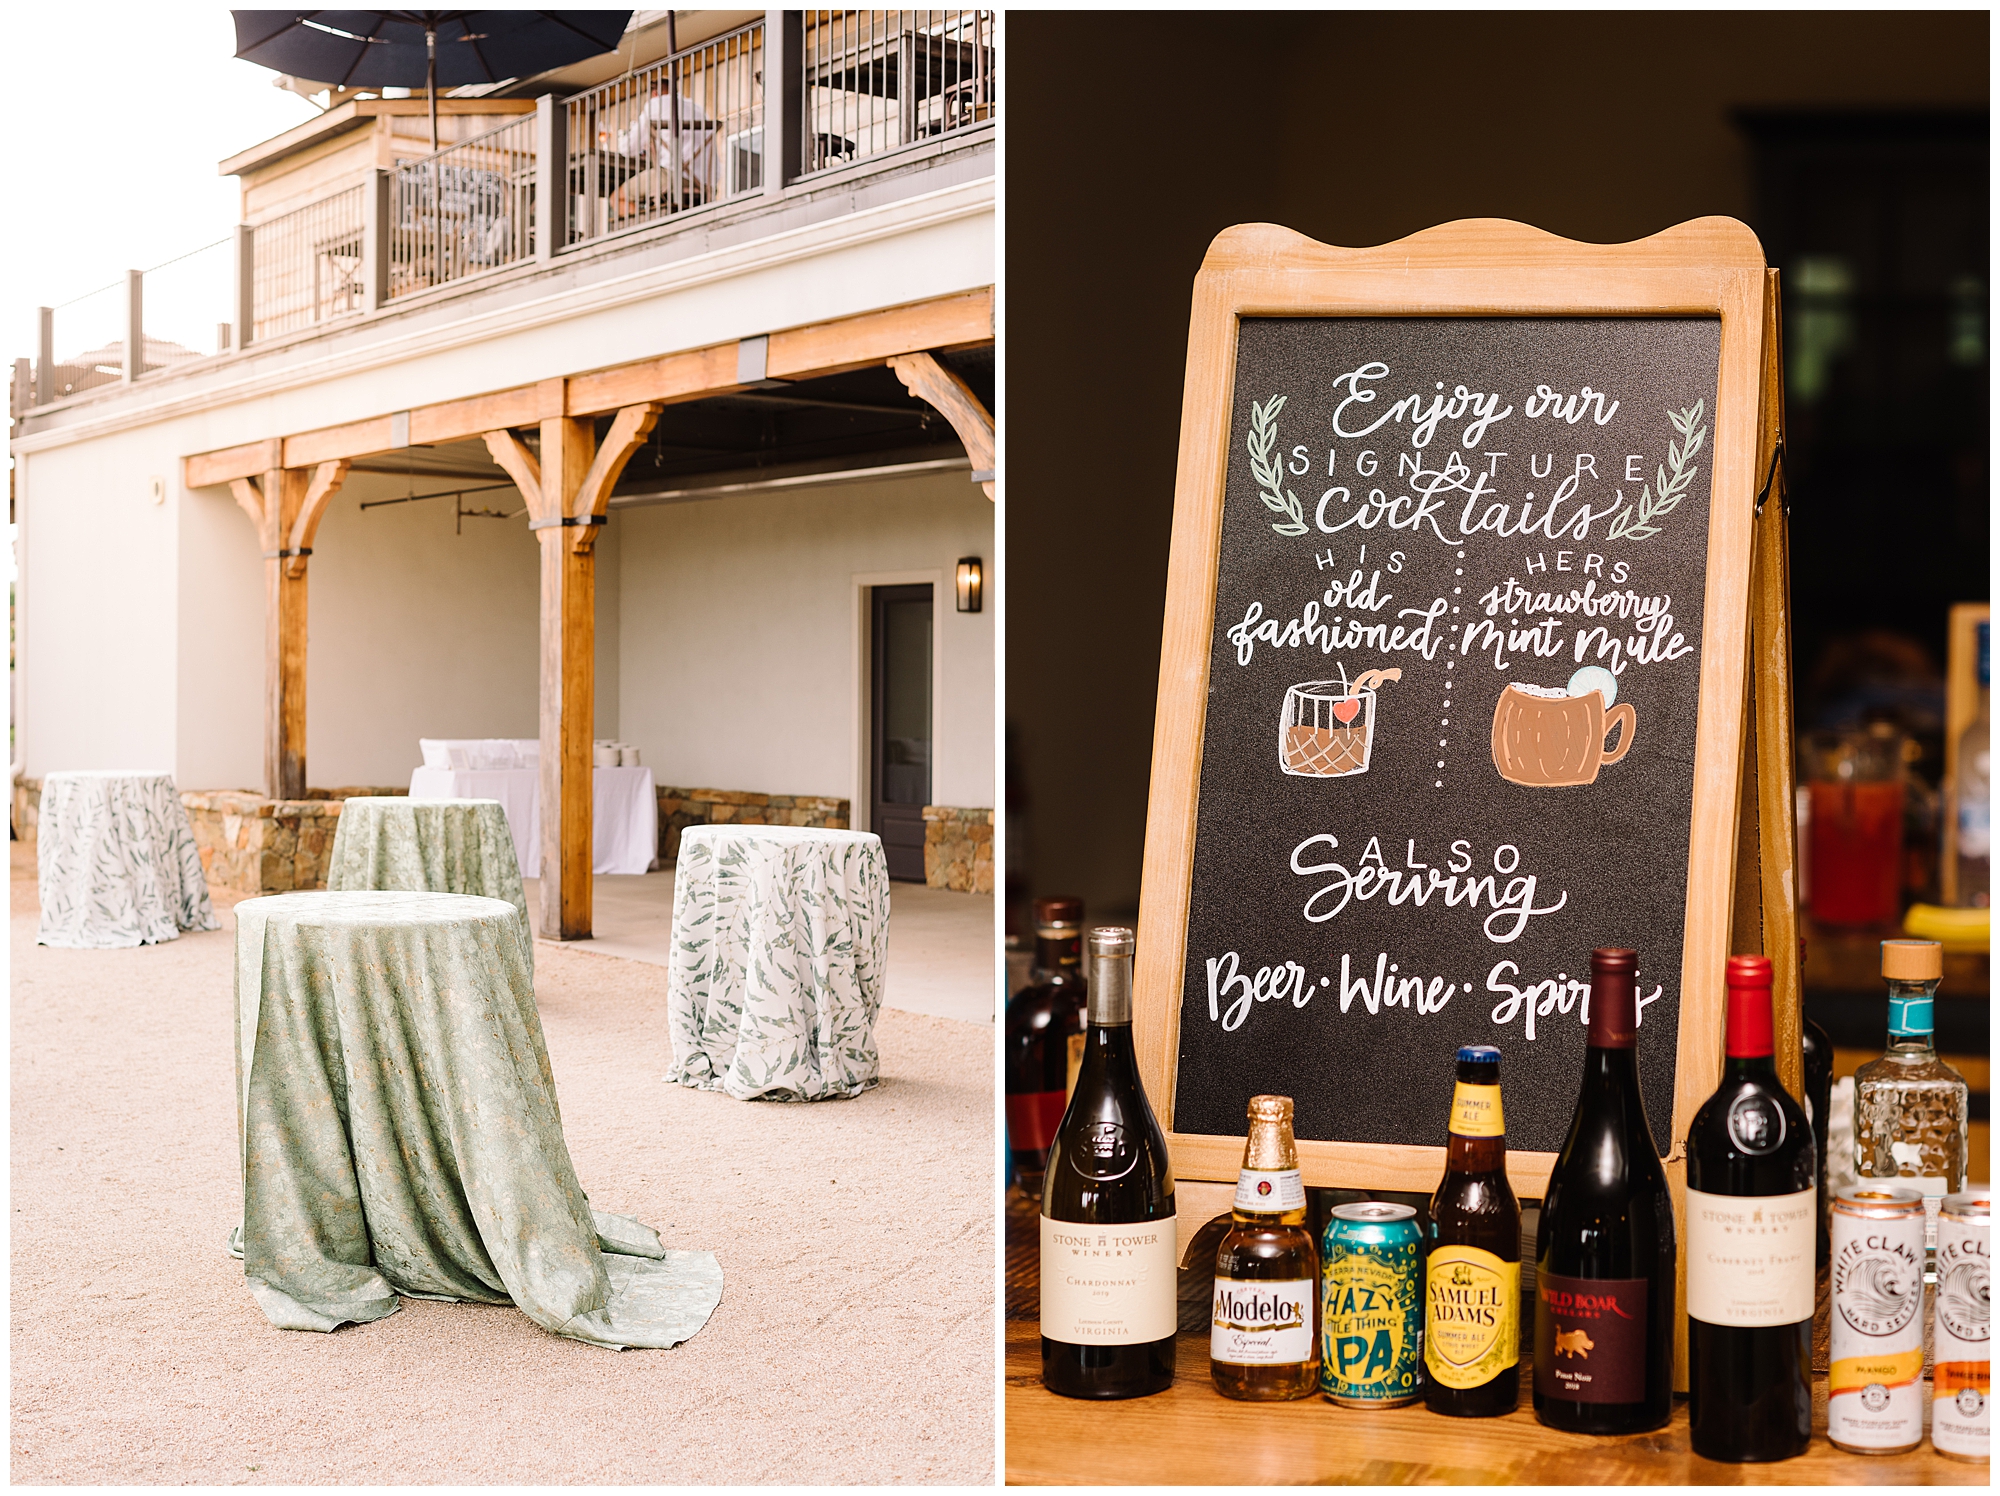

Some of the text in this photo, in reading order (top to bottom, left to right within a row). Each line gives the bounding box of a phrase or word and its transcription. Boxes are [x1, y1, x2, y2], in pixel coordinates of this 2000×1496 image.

[1332, 362, 1620, 448] Enjoy our
[1288, 445, 1644, 482] SIGNATURE
[1315, 544, 1406, 574] HIS
[1525, 552, 1631, 583] HERS
[1323, 569, 1393, 612] old
[1478, 576, 1672, 633] strawberry
[1226, 597, 1449, 667] fashioned
[1358, 835, 1521, 876] ALSO
[1289, 833, 1568, 944] Serving
[1205, 950, 1316, 1032] Beer
[1338, 952, 1456, 1016] Wine
[1462, 1110, 1480, 1122] ALE
[1052, 1233, 1159, 1248] STONE TOWER
[1071, 1249, 1135, 1258] WINERY
[1357, 1267, 1394, 1281] NEVADA
[1835, 1235, 1919, 1296] WHITE CLAW
[1219, 1290, 1293, 1322] Modelo
[1326, 1287, 1395, 1315] HAZY
[1429, 1281, 1503, 1307] SAMUEL
[1575, 1293, 1634, 1320] BOAR
[1354, 1316, 1398, 1331] THING
[1431, 1304, 1496, 1328] ADAMS
[1846, 1307, 1880, 1332] HARD
[1073, 1326, 1130, 1336] VIRGINIA
[1437, 1329, 1486, 1343] SUMMER ALE
[1855, 1365, 1898, 1376] MANGO
